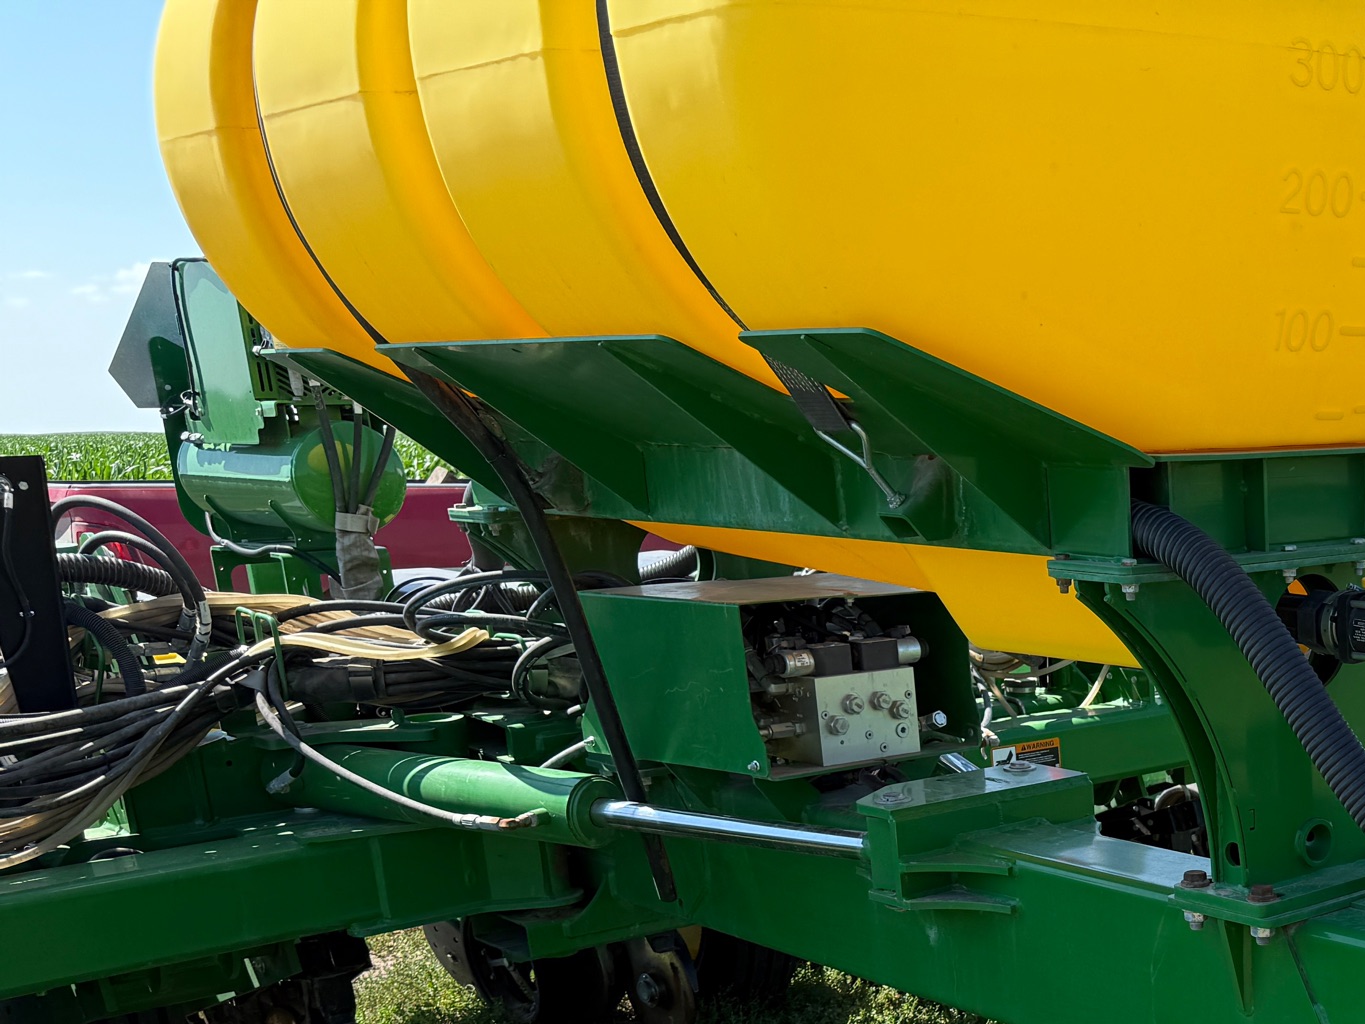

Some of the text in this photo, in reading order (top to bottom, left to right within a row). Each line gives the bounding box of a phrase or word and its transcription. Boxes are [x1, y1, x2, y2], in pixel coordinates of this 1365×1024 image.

[1290, 37, 1364, 94] 300
[1280, 168, 1353, 218] 200
[1275, 309, 1335, 352] 100
[1026, 740, 1055, 749] WARNING
